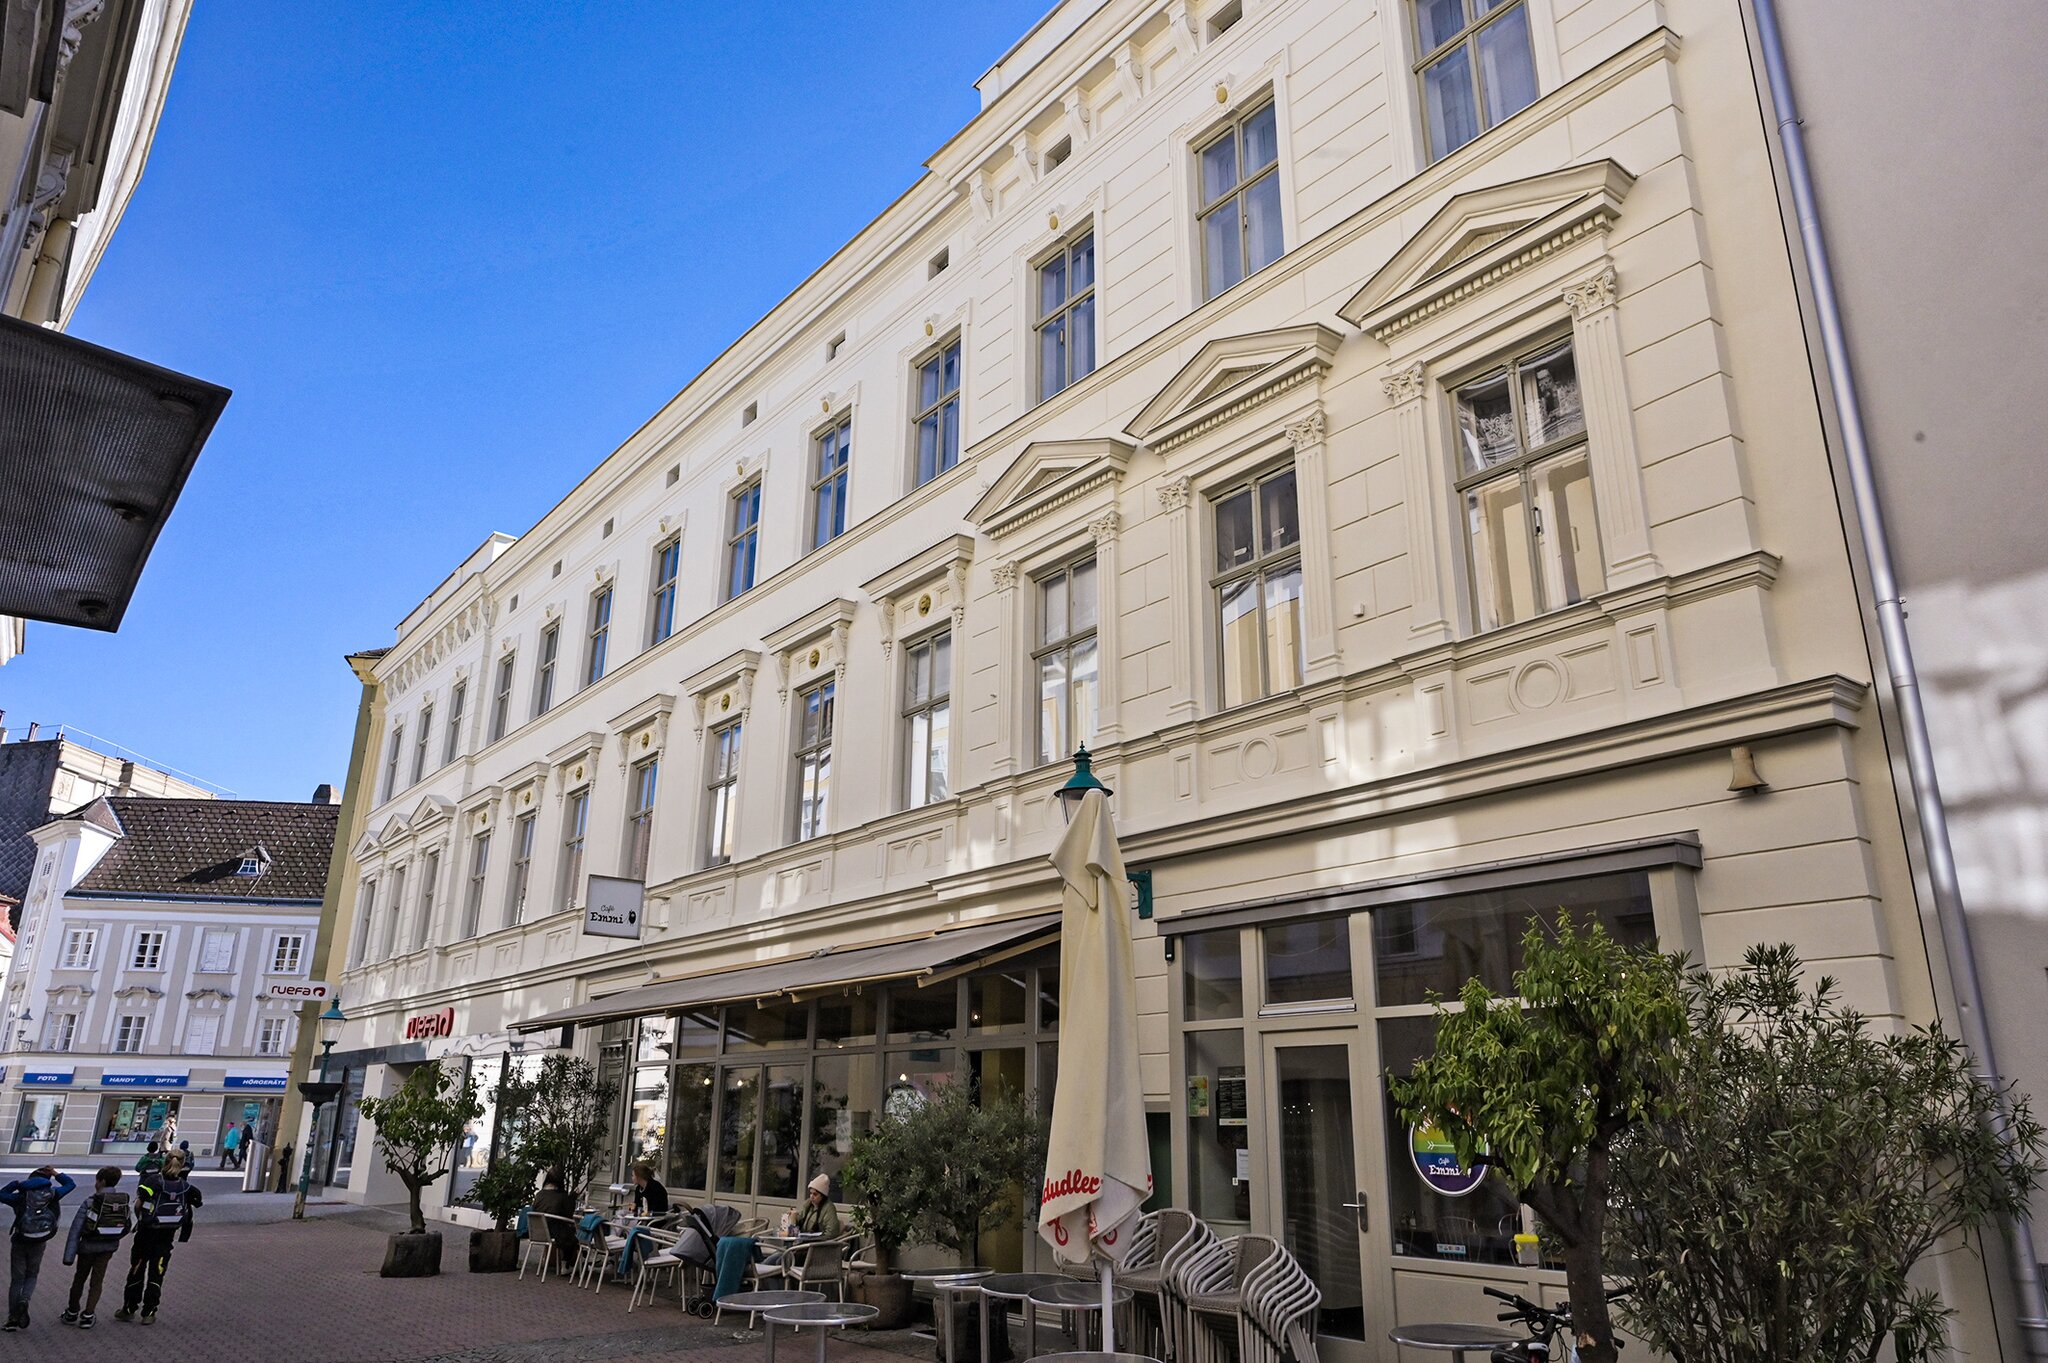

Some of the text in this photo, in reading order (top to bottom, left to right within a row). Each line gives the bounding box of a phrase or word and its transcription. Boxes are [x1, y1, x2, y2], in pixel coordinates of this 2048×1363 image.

[590, 911, 624, 924] Emmi
[271, 985, 311, 996] ruefa
[1428, 1164, 1461, 1176] Emmi
